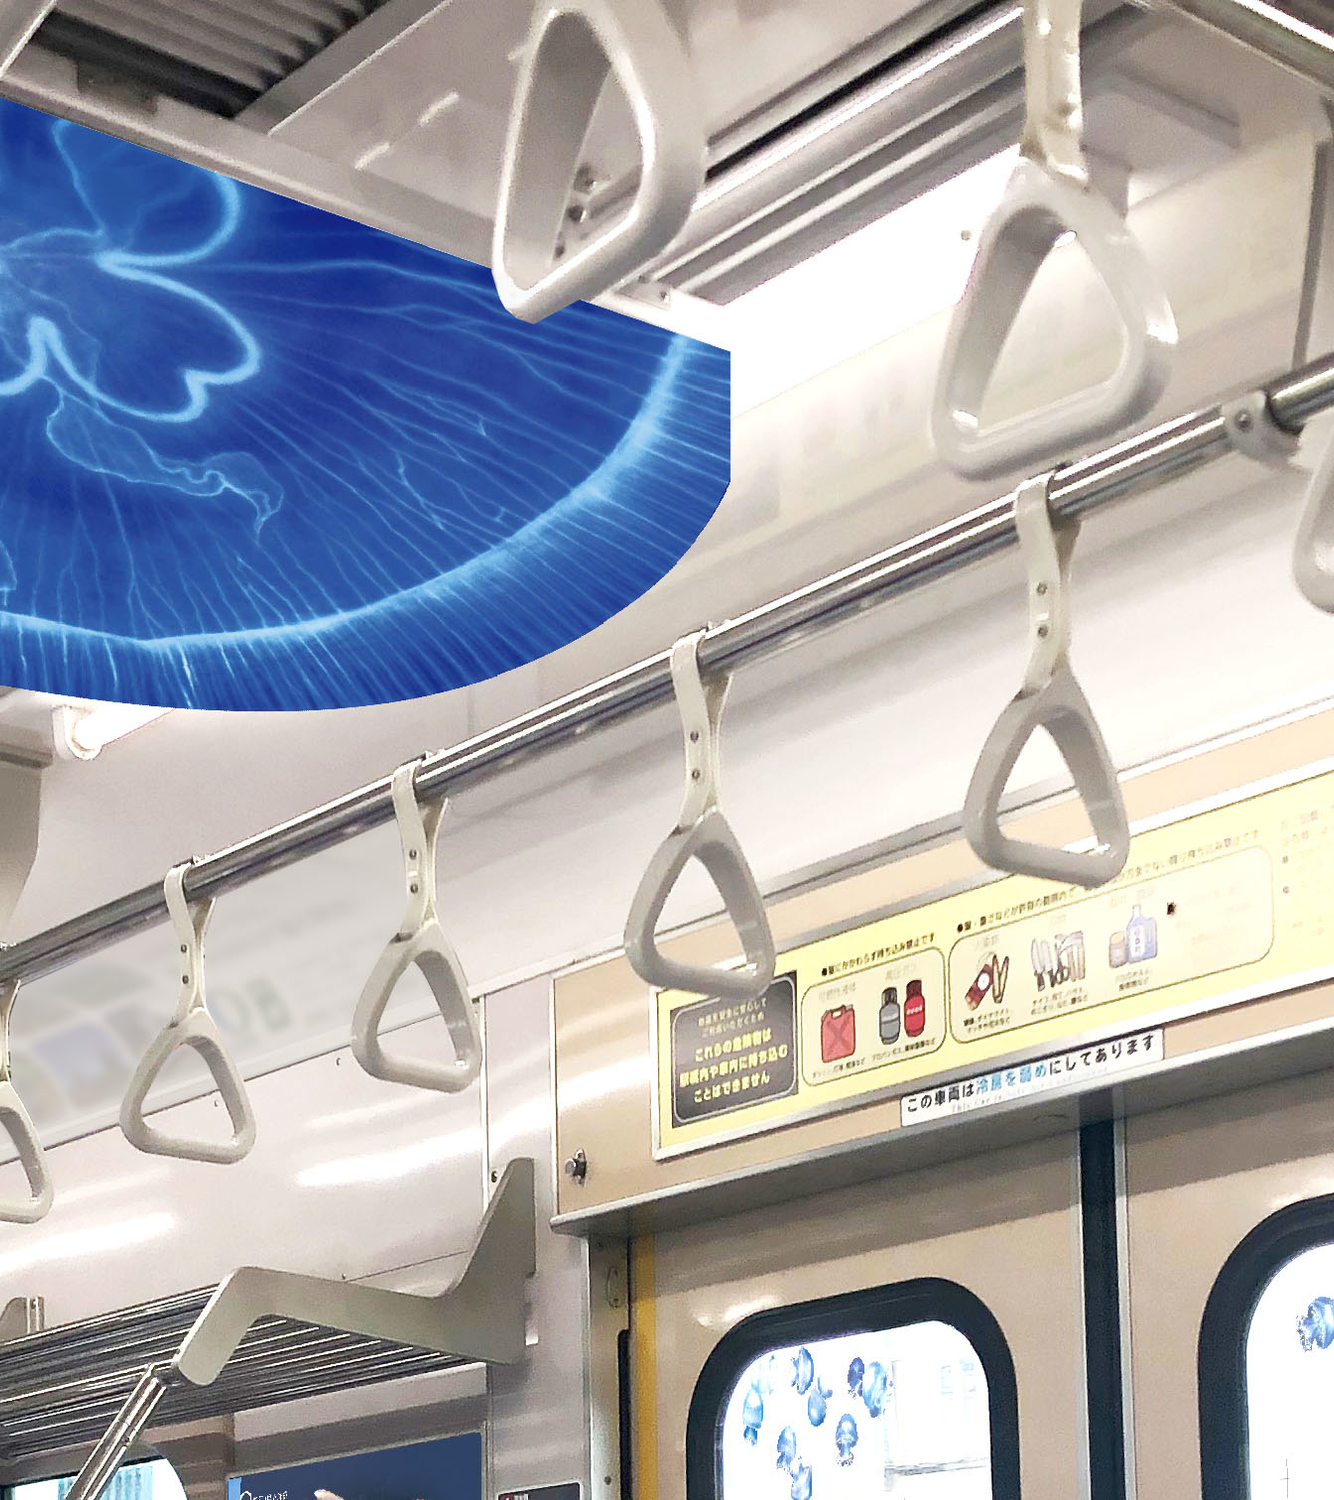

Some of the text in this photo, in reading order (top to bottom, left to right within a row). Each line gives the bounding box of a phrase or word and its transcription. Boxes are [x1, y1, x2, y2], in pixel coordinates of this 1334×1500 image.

[907, 1034, 1155, 1113] この車両は冷房を弱めにしてあります
